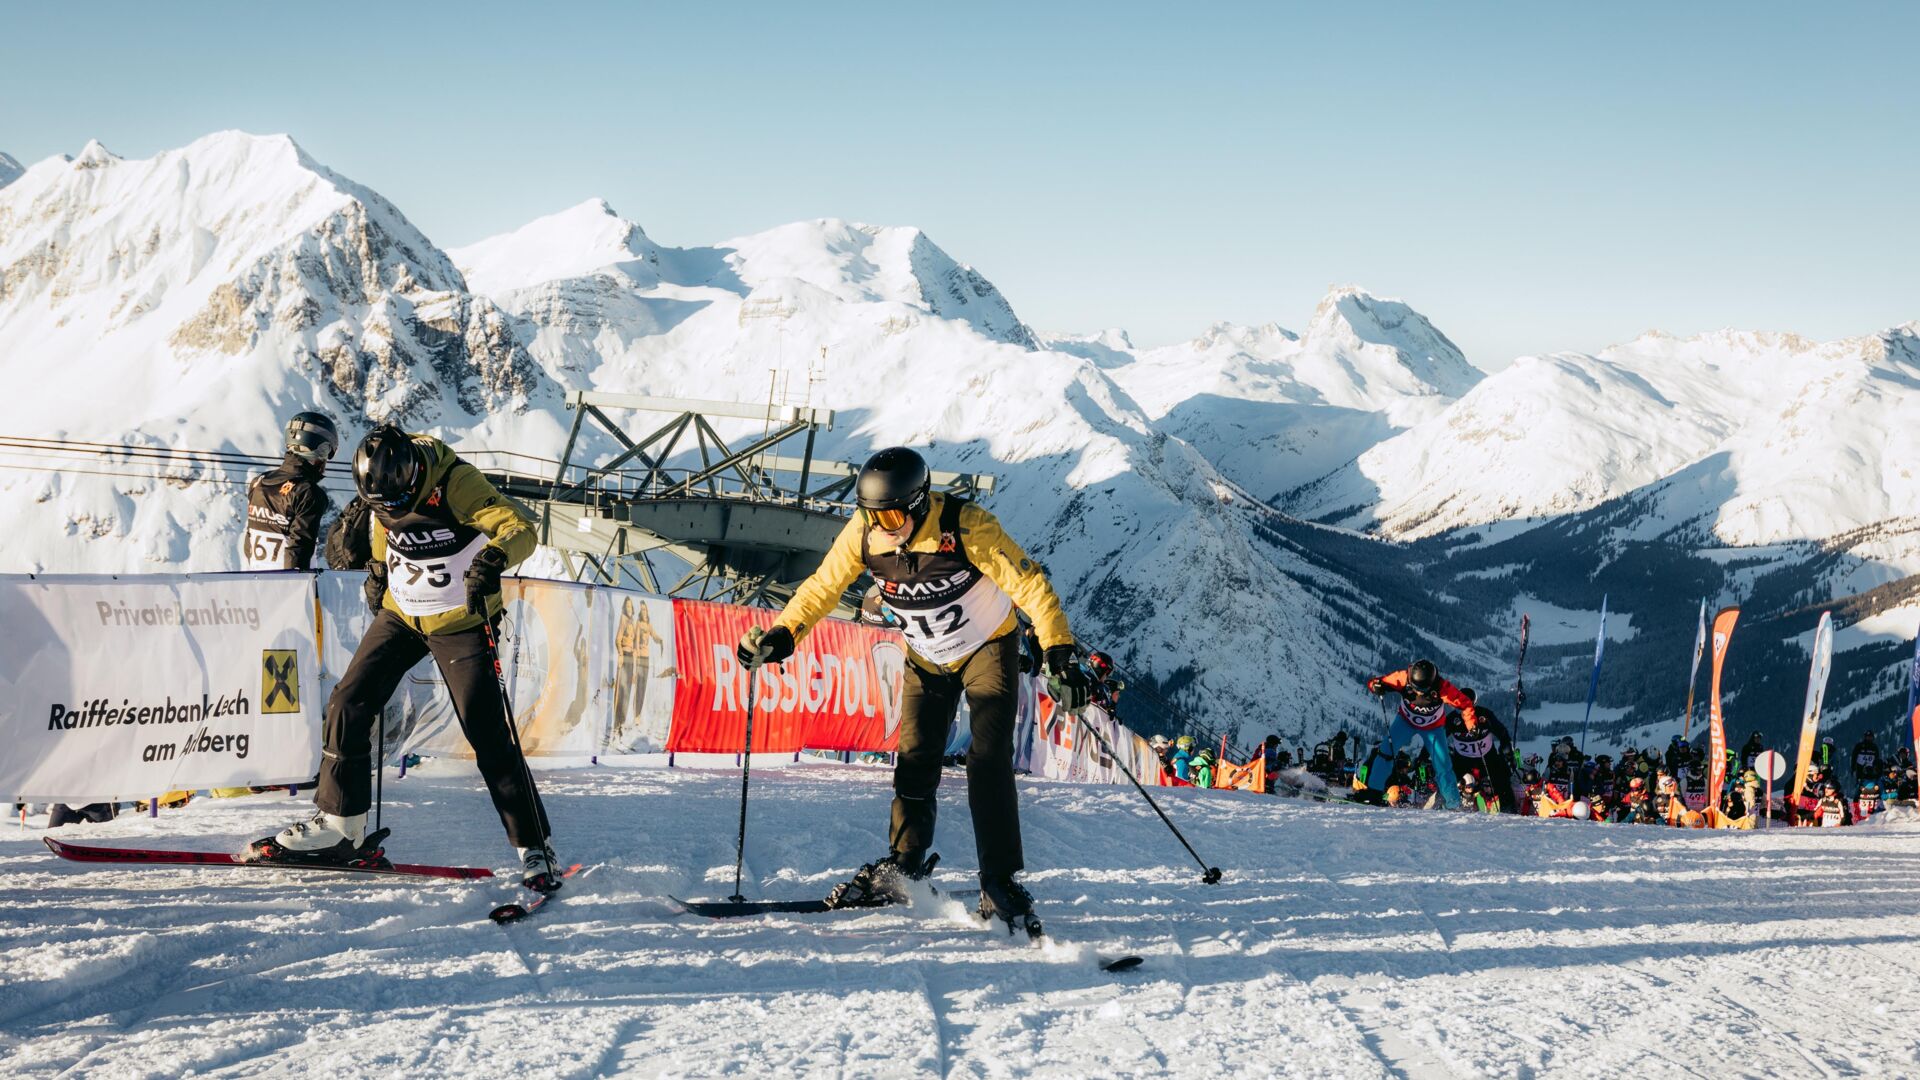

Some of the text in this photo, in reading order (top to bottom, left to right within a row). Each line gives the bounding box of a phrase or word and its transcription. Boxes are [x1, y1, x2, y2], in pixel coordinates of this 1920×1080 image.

[384, 527, 456, 546] MUS
[48, 688, 249, 730] Raiffeisenbank Lech
[142, 726, 249, 762] am Arlberg
